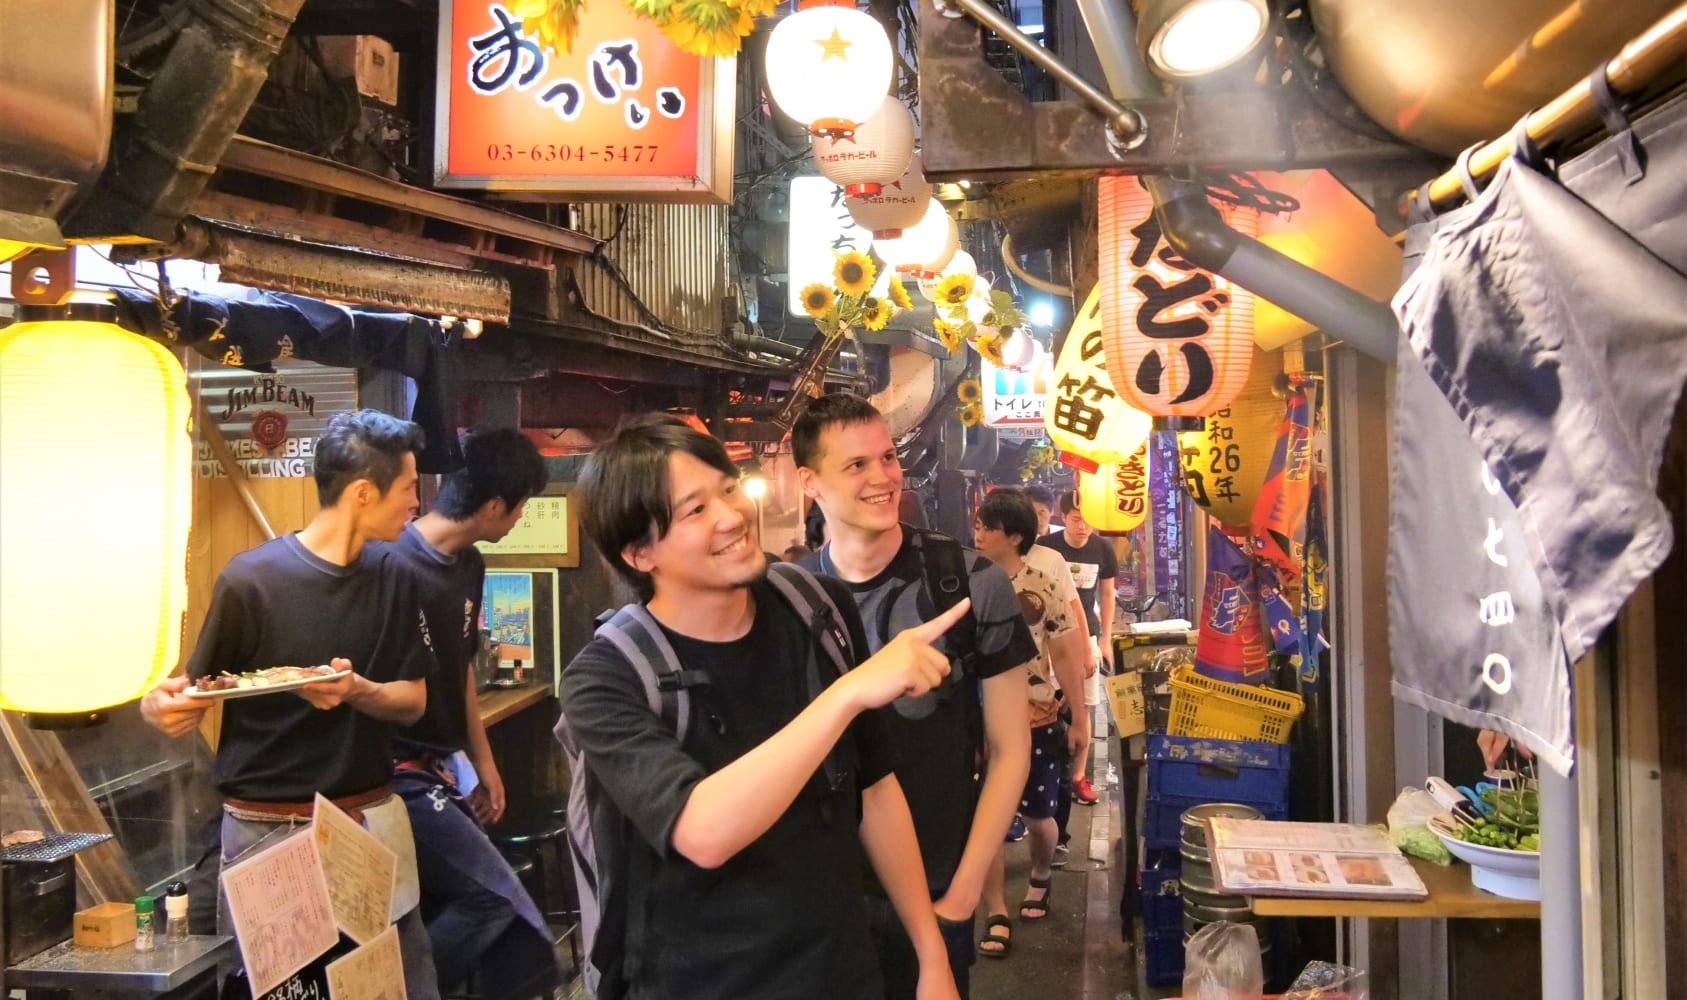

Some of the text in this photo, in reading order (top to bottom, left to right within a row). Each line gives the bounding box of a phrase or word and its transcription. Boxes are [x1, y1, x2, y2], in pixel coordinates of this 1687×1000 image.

[487, 143, 659, 162] 03-6304-5477
[221, 378, 316, 420] JIM BEAM
[994, 398, 1033, 411] トイレ
[285, 437, 317, 458] BE
